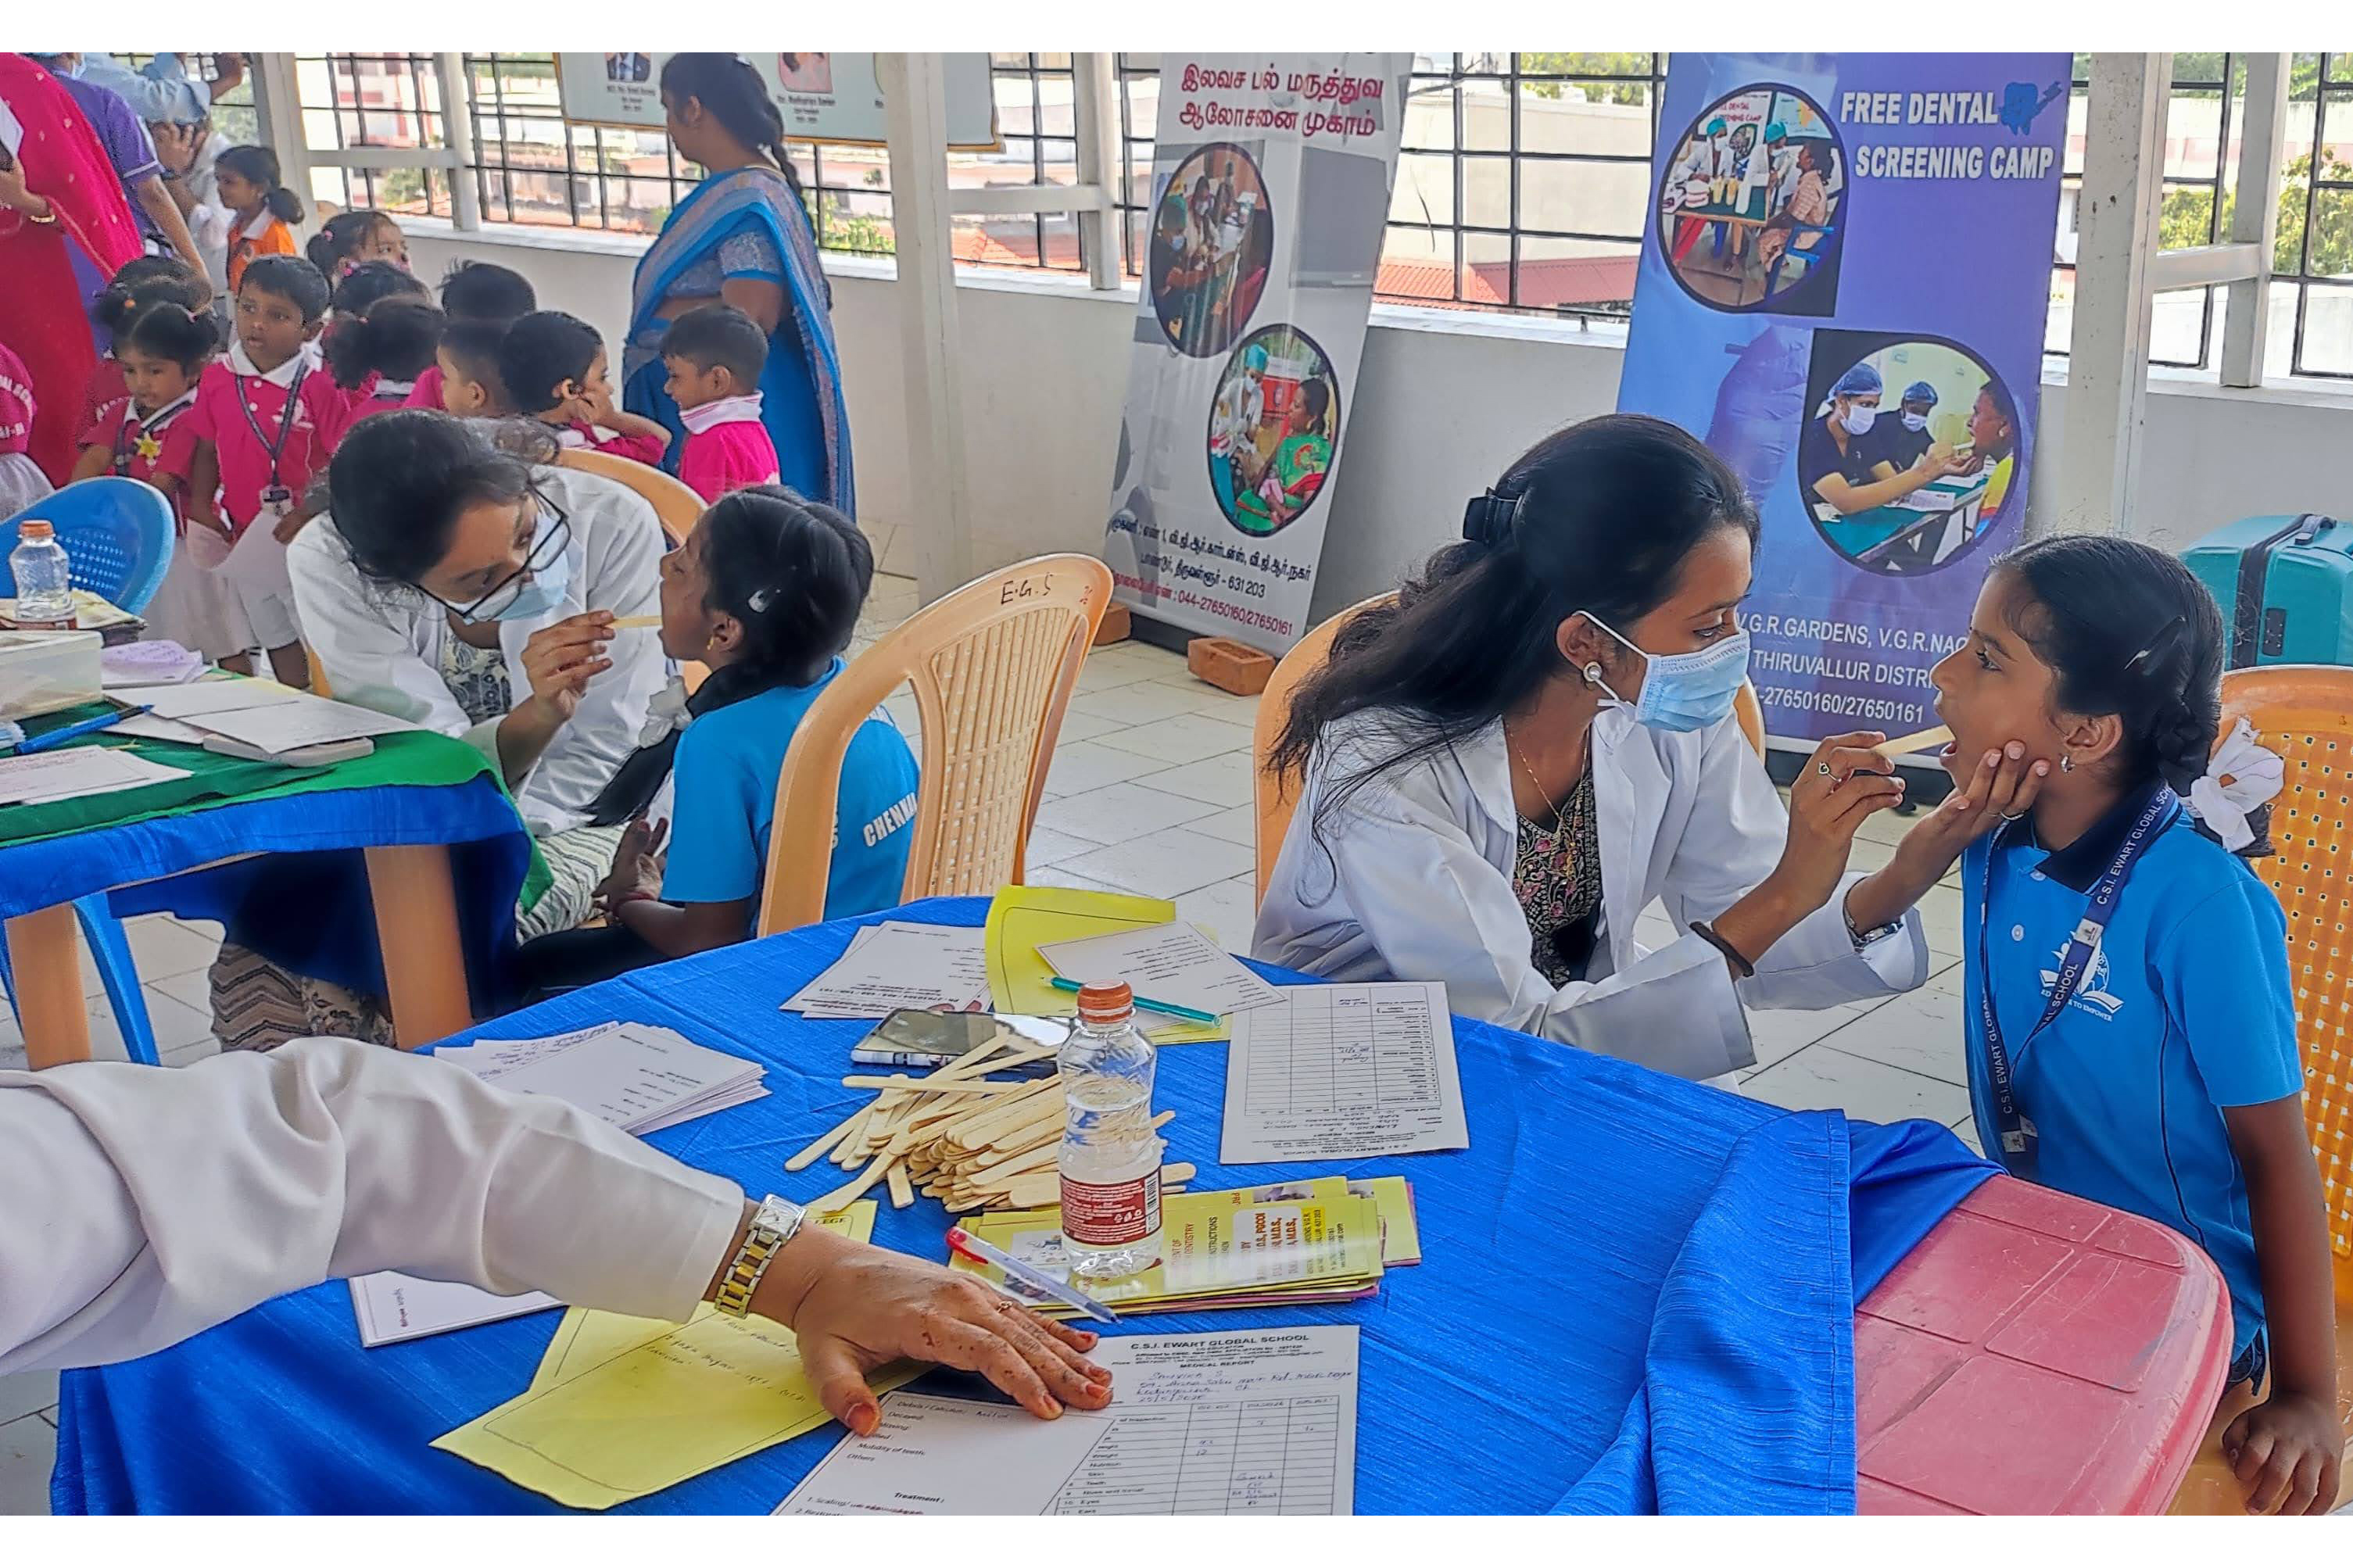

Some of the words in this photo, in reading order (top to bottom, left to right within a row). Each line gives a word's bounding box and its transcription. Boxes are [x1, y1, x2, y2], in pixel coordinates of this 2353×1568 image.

[1181, 63, 1246, 92] இலவச
[1252, 63, 1280, 90] பல்
[1286, 67, 1384, 105] மருத்துவ
[1179, 101, 1299, 131] ஆலோசனை
[1302, 109, 1377, 138] முகாம்
[1840, 91, 1900, 124] FREE
[1907, 92, 1999, 125] DENTAL
[1855, 146, 1983, 179] SCREENING
[1989, 146, 2055, 179] CAMP
[1178, 589, 1294, 636] 044-27650160/27650161
[1736, 612, 1871, 649] VG.R.GARDENS,
[1753, 649, 1871, 682] THIRUVALLUR
[1755, 685, 1924, 724] -27650160/27650161
[863, 792, 918, 847] CHENN
[2097, 878, 2118, 905] C.S.I.
[2110, 840, 2137, 877] EWART
[2131, 804, 2162, 839] GLOBAL
[2155, 785, 2172, 805] SCH
[2051, 963, 2079, 1008] SCHOOL
[1990, 1044, 2007, 1085] EWART
[1208, 1216, 1218, 1257] NSTRUCTIONS
[1209, 1337, 1257, 1346] GLOBAL
[1261, 1334, 1310, 1343] SCHOOL
